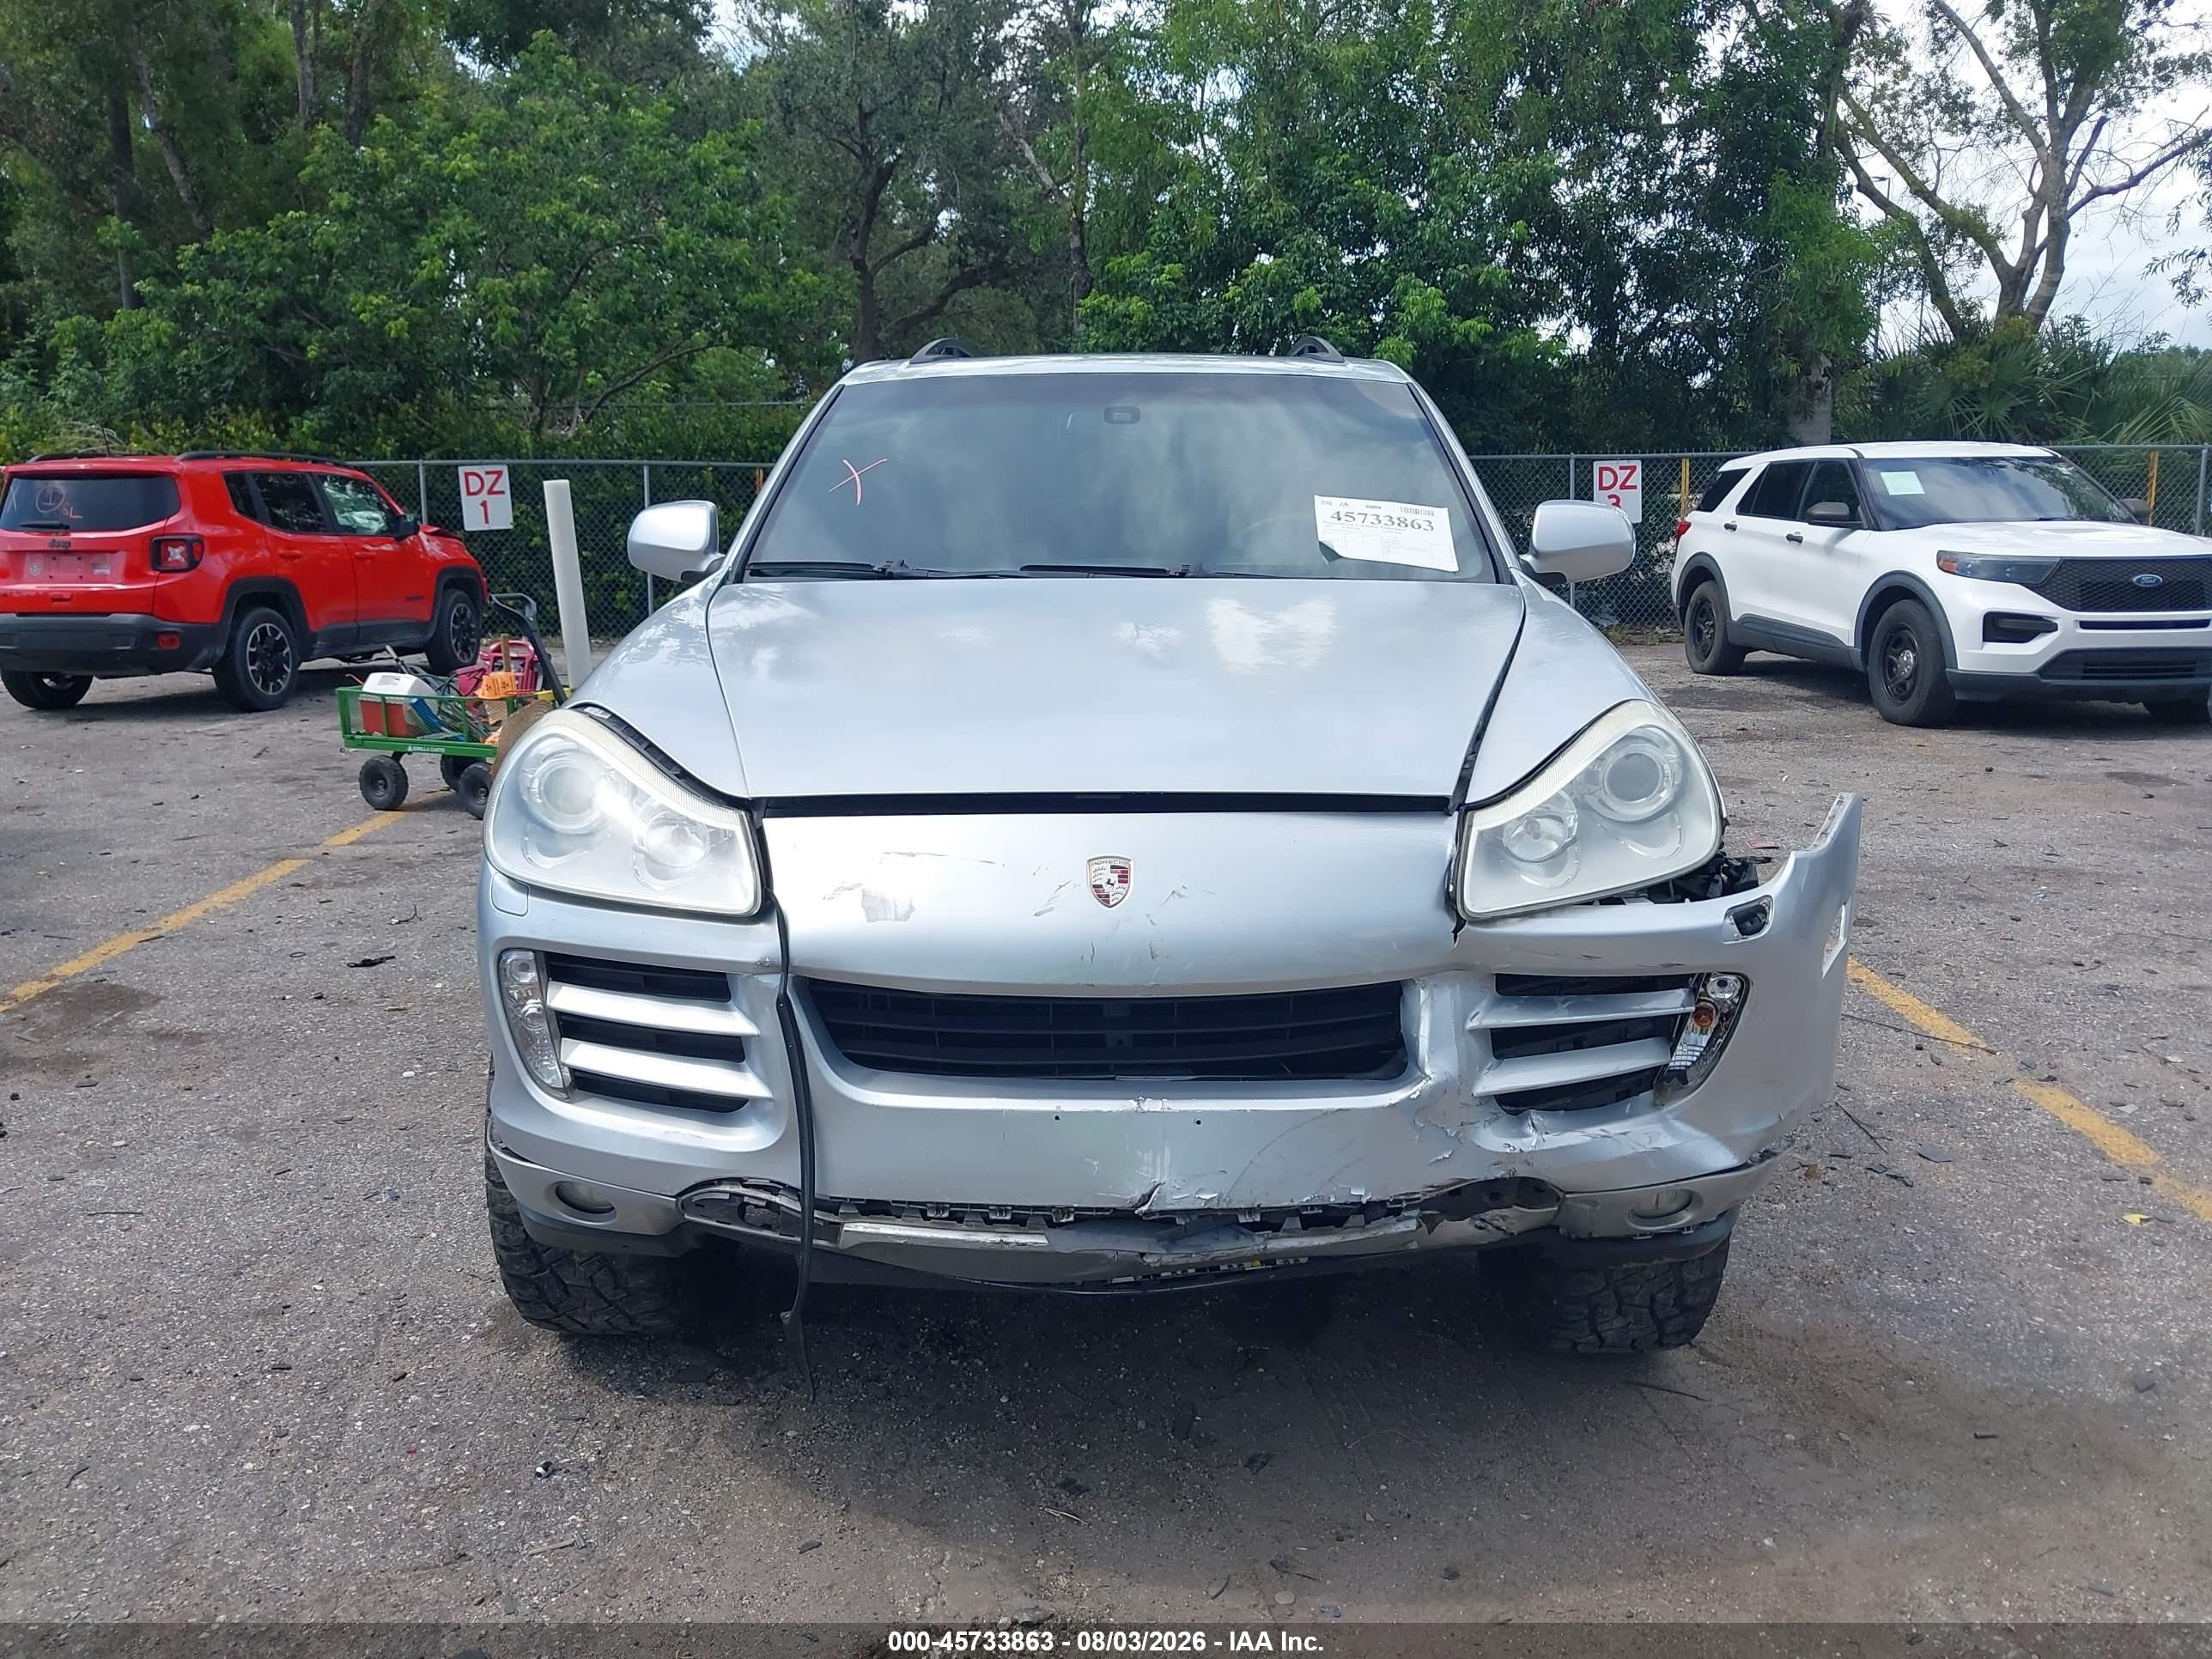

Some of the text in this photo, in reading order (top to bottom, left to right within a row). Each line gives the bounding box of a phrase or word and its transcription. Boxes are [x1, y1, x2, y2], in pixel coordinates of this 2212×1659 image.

[464, 470, 505, 496] DZ
[1598, 465, 1638, 491] DZ
[480, 500, 489, 525] 1
[1330, 510, 1435, 532] 45733863
